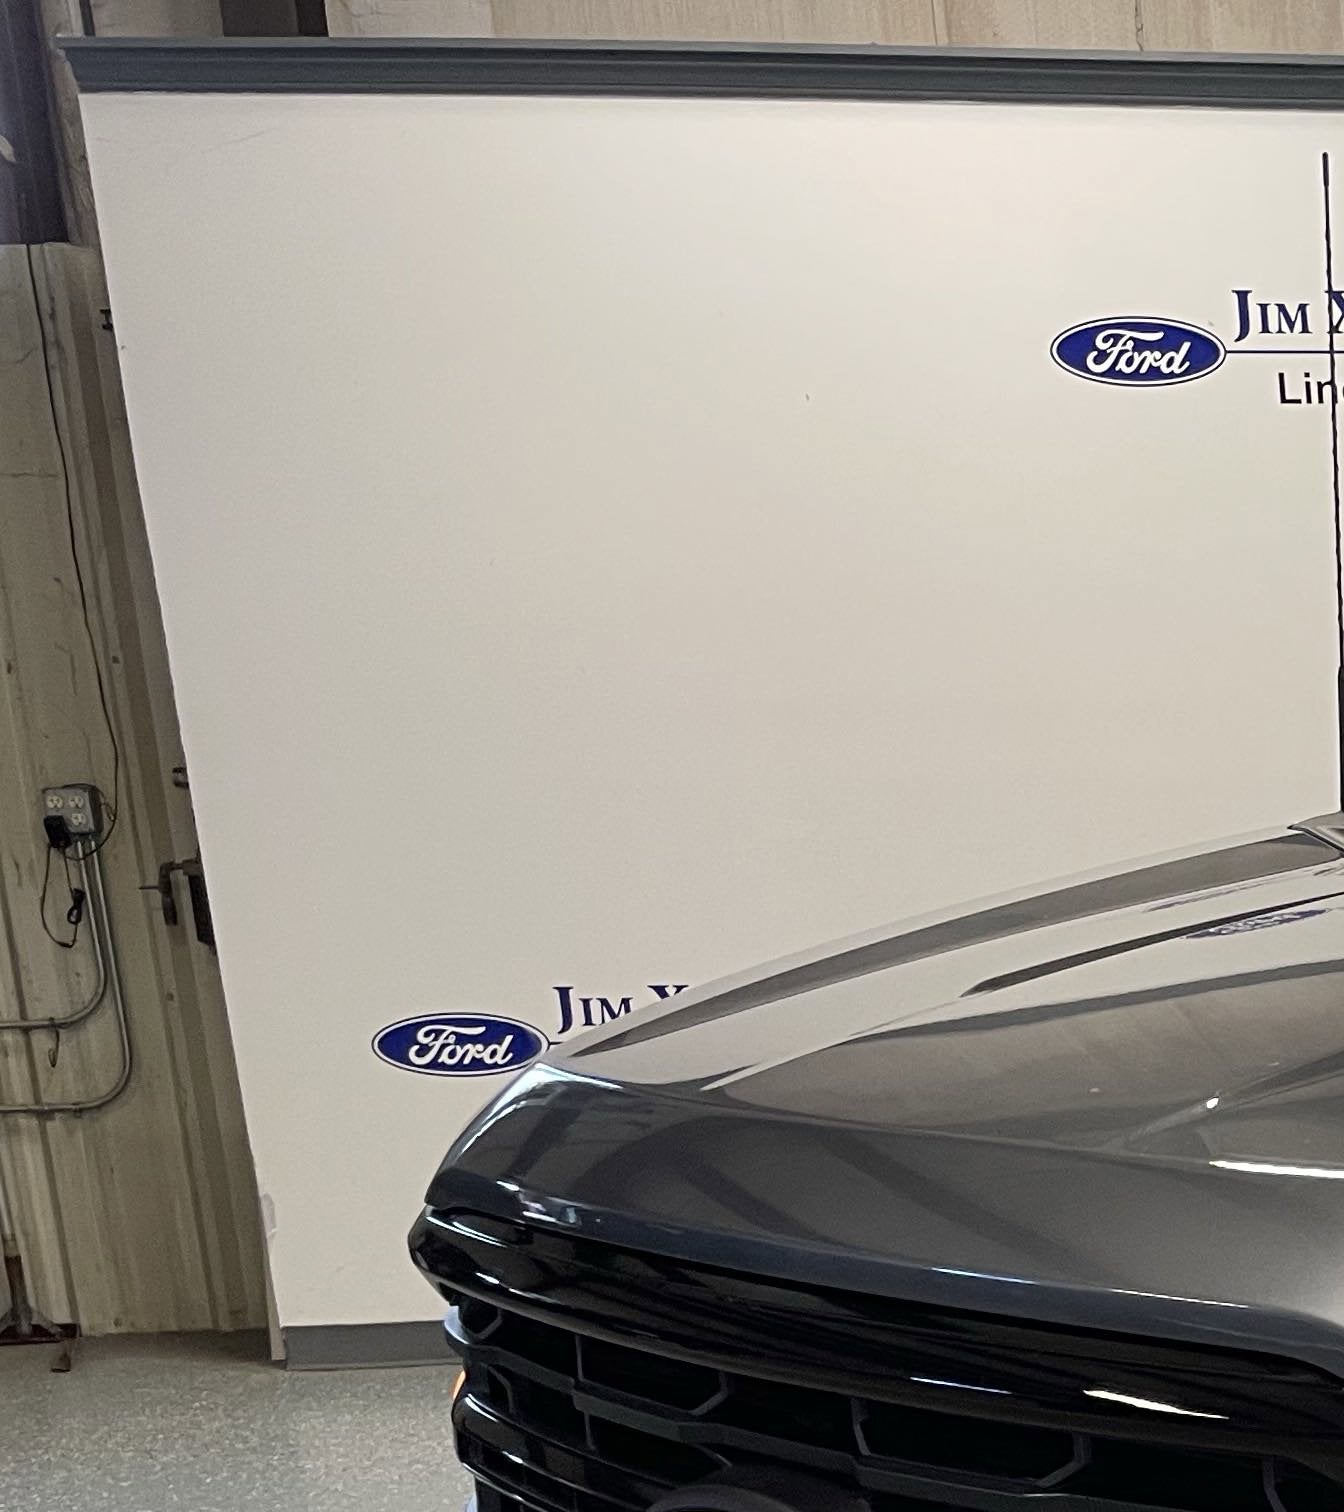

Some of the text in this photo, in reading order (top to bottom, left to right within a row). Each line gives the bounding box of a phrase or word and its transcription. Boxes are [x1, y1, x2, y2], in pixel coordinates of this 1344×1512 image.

[1230, 289, 1312, 343] JIM
[1086, 329, 1190, 375] Ford
[551, 986, 634, 1034] JIM
[408, 1024, 514, 1066] Ford
